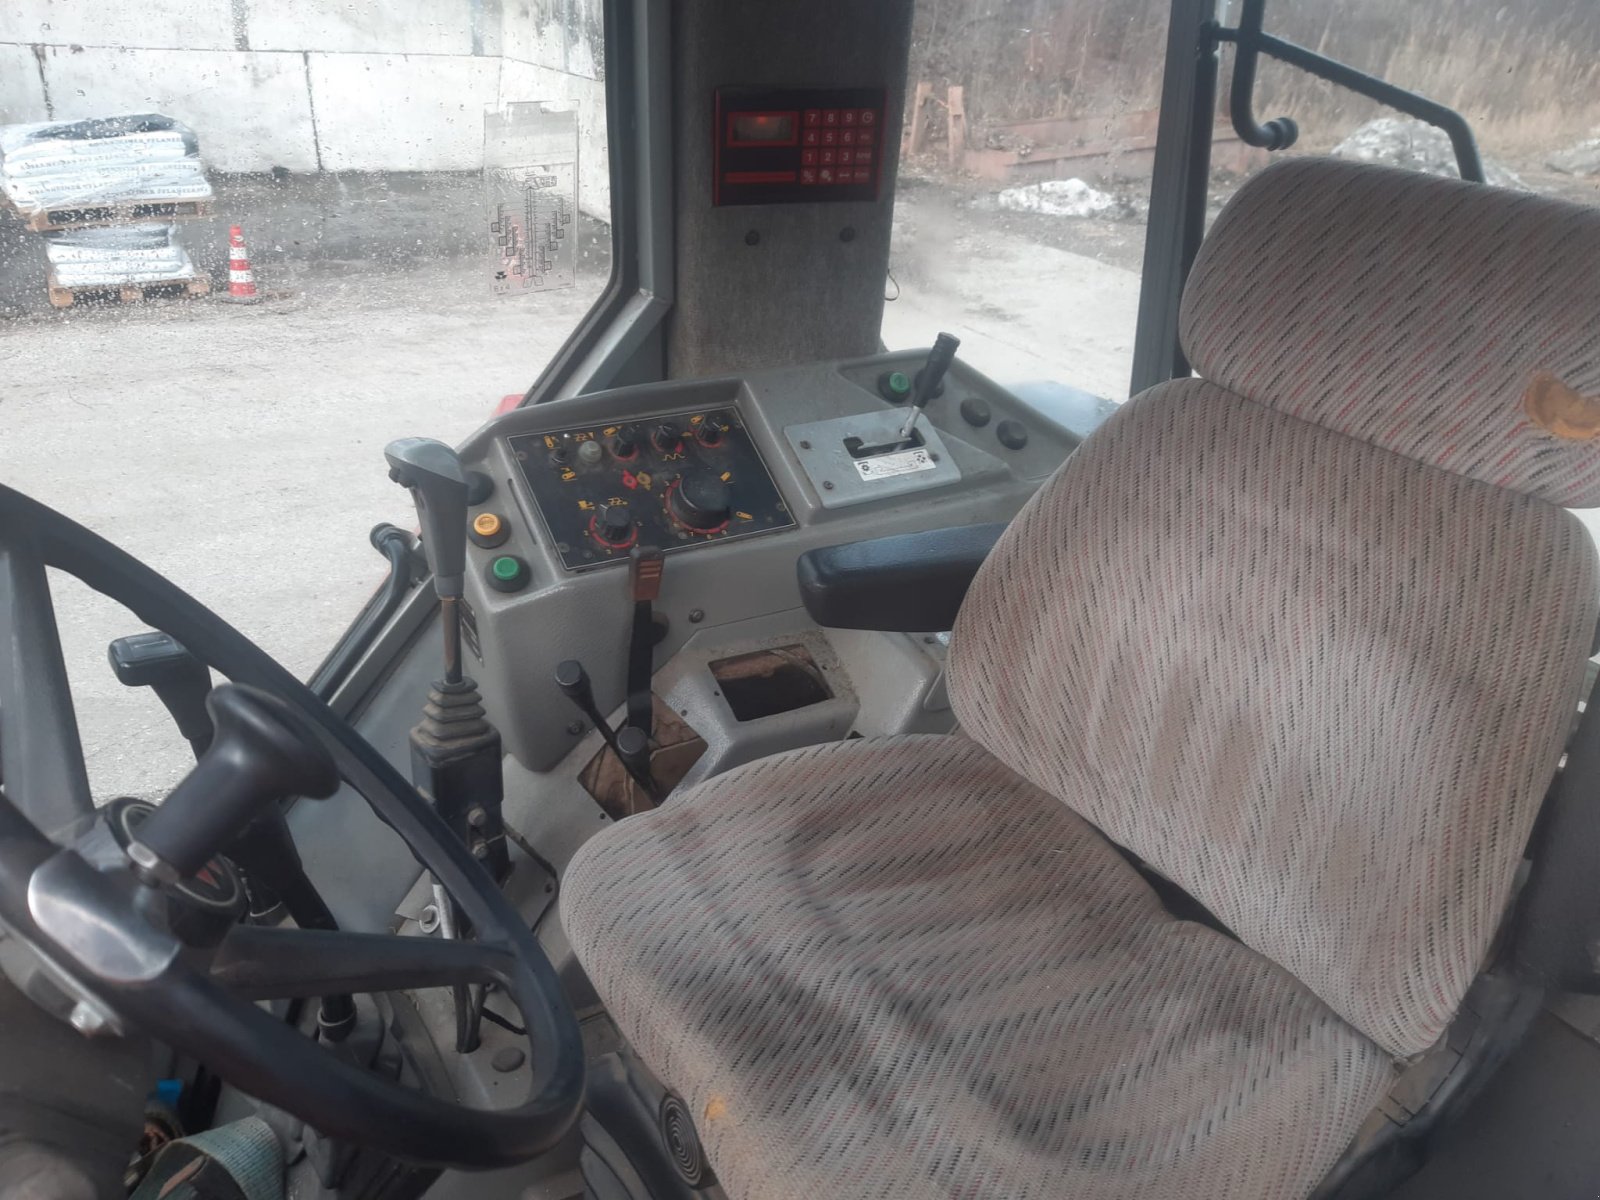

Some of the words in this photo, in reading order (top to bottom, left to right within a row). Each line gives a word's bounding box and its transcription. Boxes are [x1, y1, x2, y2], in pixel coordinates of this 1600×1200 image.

[808, 113, 817, 123] 7
[827, 113, 834, 123] 8
[845, 112, 853, 123] 9
[826, 132, 833, 143] 5
[844, 132, 852, 143] 6
[824, 152, 832, 162] 2
[842, 152, 849, 161] 3
